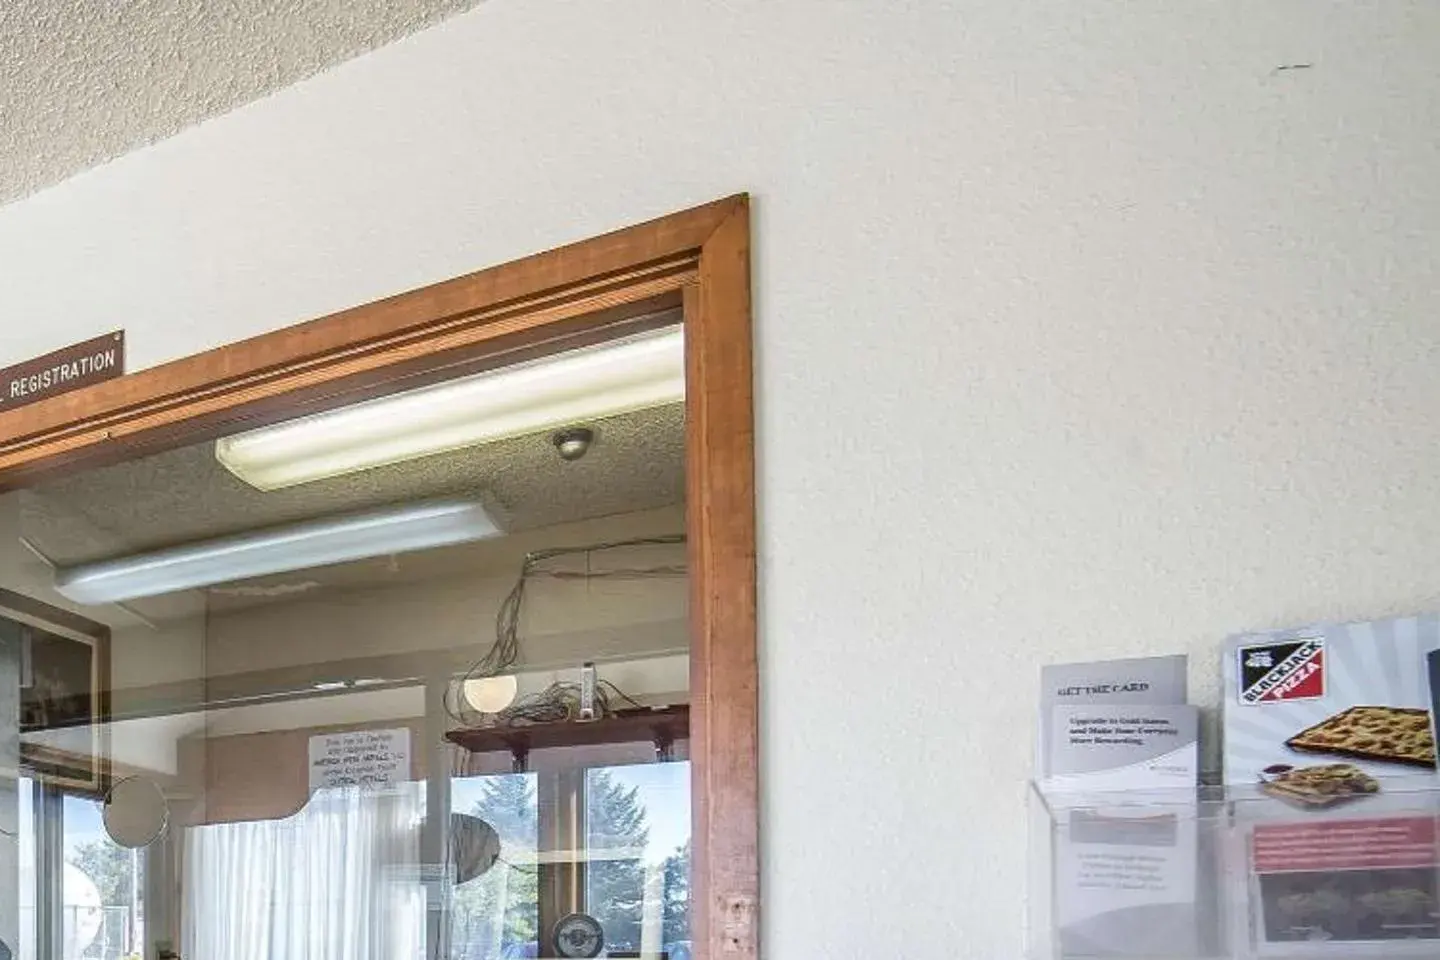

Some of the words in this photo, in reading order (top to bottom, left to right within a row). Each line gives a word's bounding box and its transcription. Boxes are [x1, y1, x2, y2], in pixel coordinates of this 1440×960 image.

[11, 349, 115, 398] REGISTRATION
[1113, 682, 1149, 692] CARD
[1244, 641, 1322, 702] BLACKJACK
[1272, 661, 1320, 698] PIZZA
